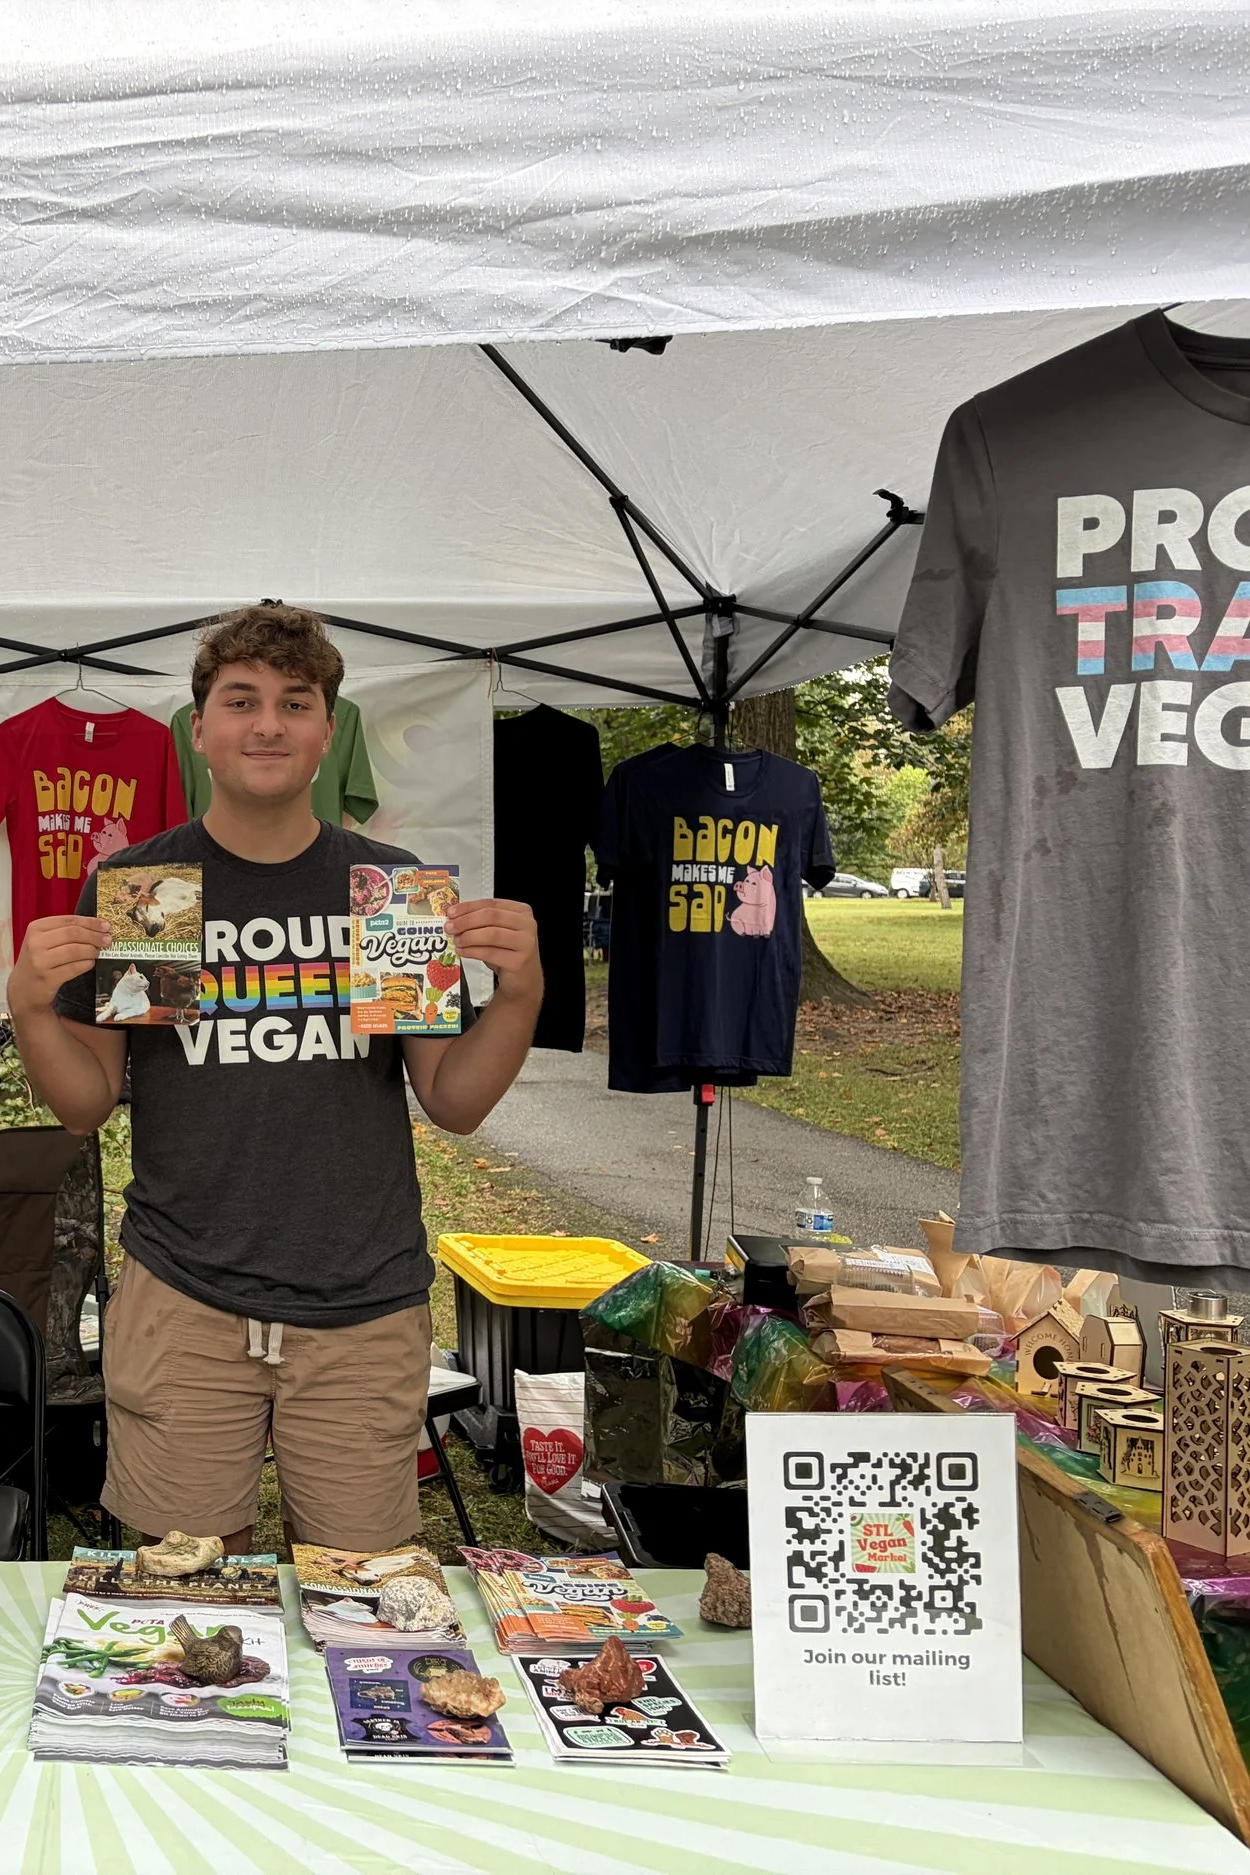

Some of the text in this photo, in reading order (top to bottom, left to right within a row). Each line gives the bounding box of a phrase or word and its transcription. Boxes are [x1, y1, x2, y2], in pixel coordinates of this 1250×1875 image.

[74, 816, 92, 834] ME
[717, 866, 736, 884] ME
[397, 926, 443, 936] GOING
[166, 942, 199, 952] CHOICES
[359, 931, 448, 968] Vegan
[174, 1015, 370, 1066] VEGAN
[1025, 1332, 1058, 1356] WELCOME
[530, 1440, 565, 1453] TASTE IT.
[547, 1452, 567, 1464] LOVE
[568, 1453, 577, 1465] IT
[862, 1524, 894, 1537] STL
[856, 1537, 908, 1552] Vegan
[867, 1552, 908, 1563] Market
[78, 1575, 265, 1590] KILLS THE PLANET
[522, 1580, 628, 1601] Vegan
[803, 1649, 970, 1670] Join our mailing
[869, 1670, 906, 1686] list!
